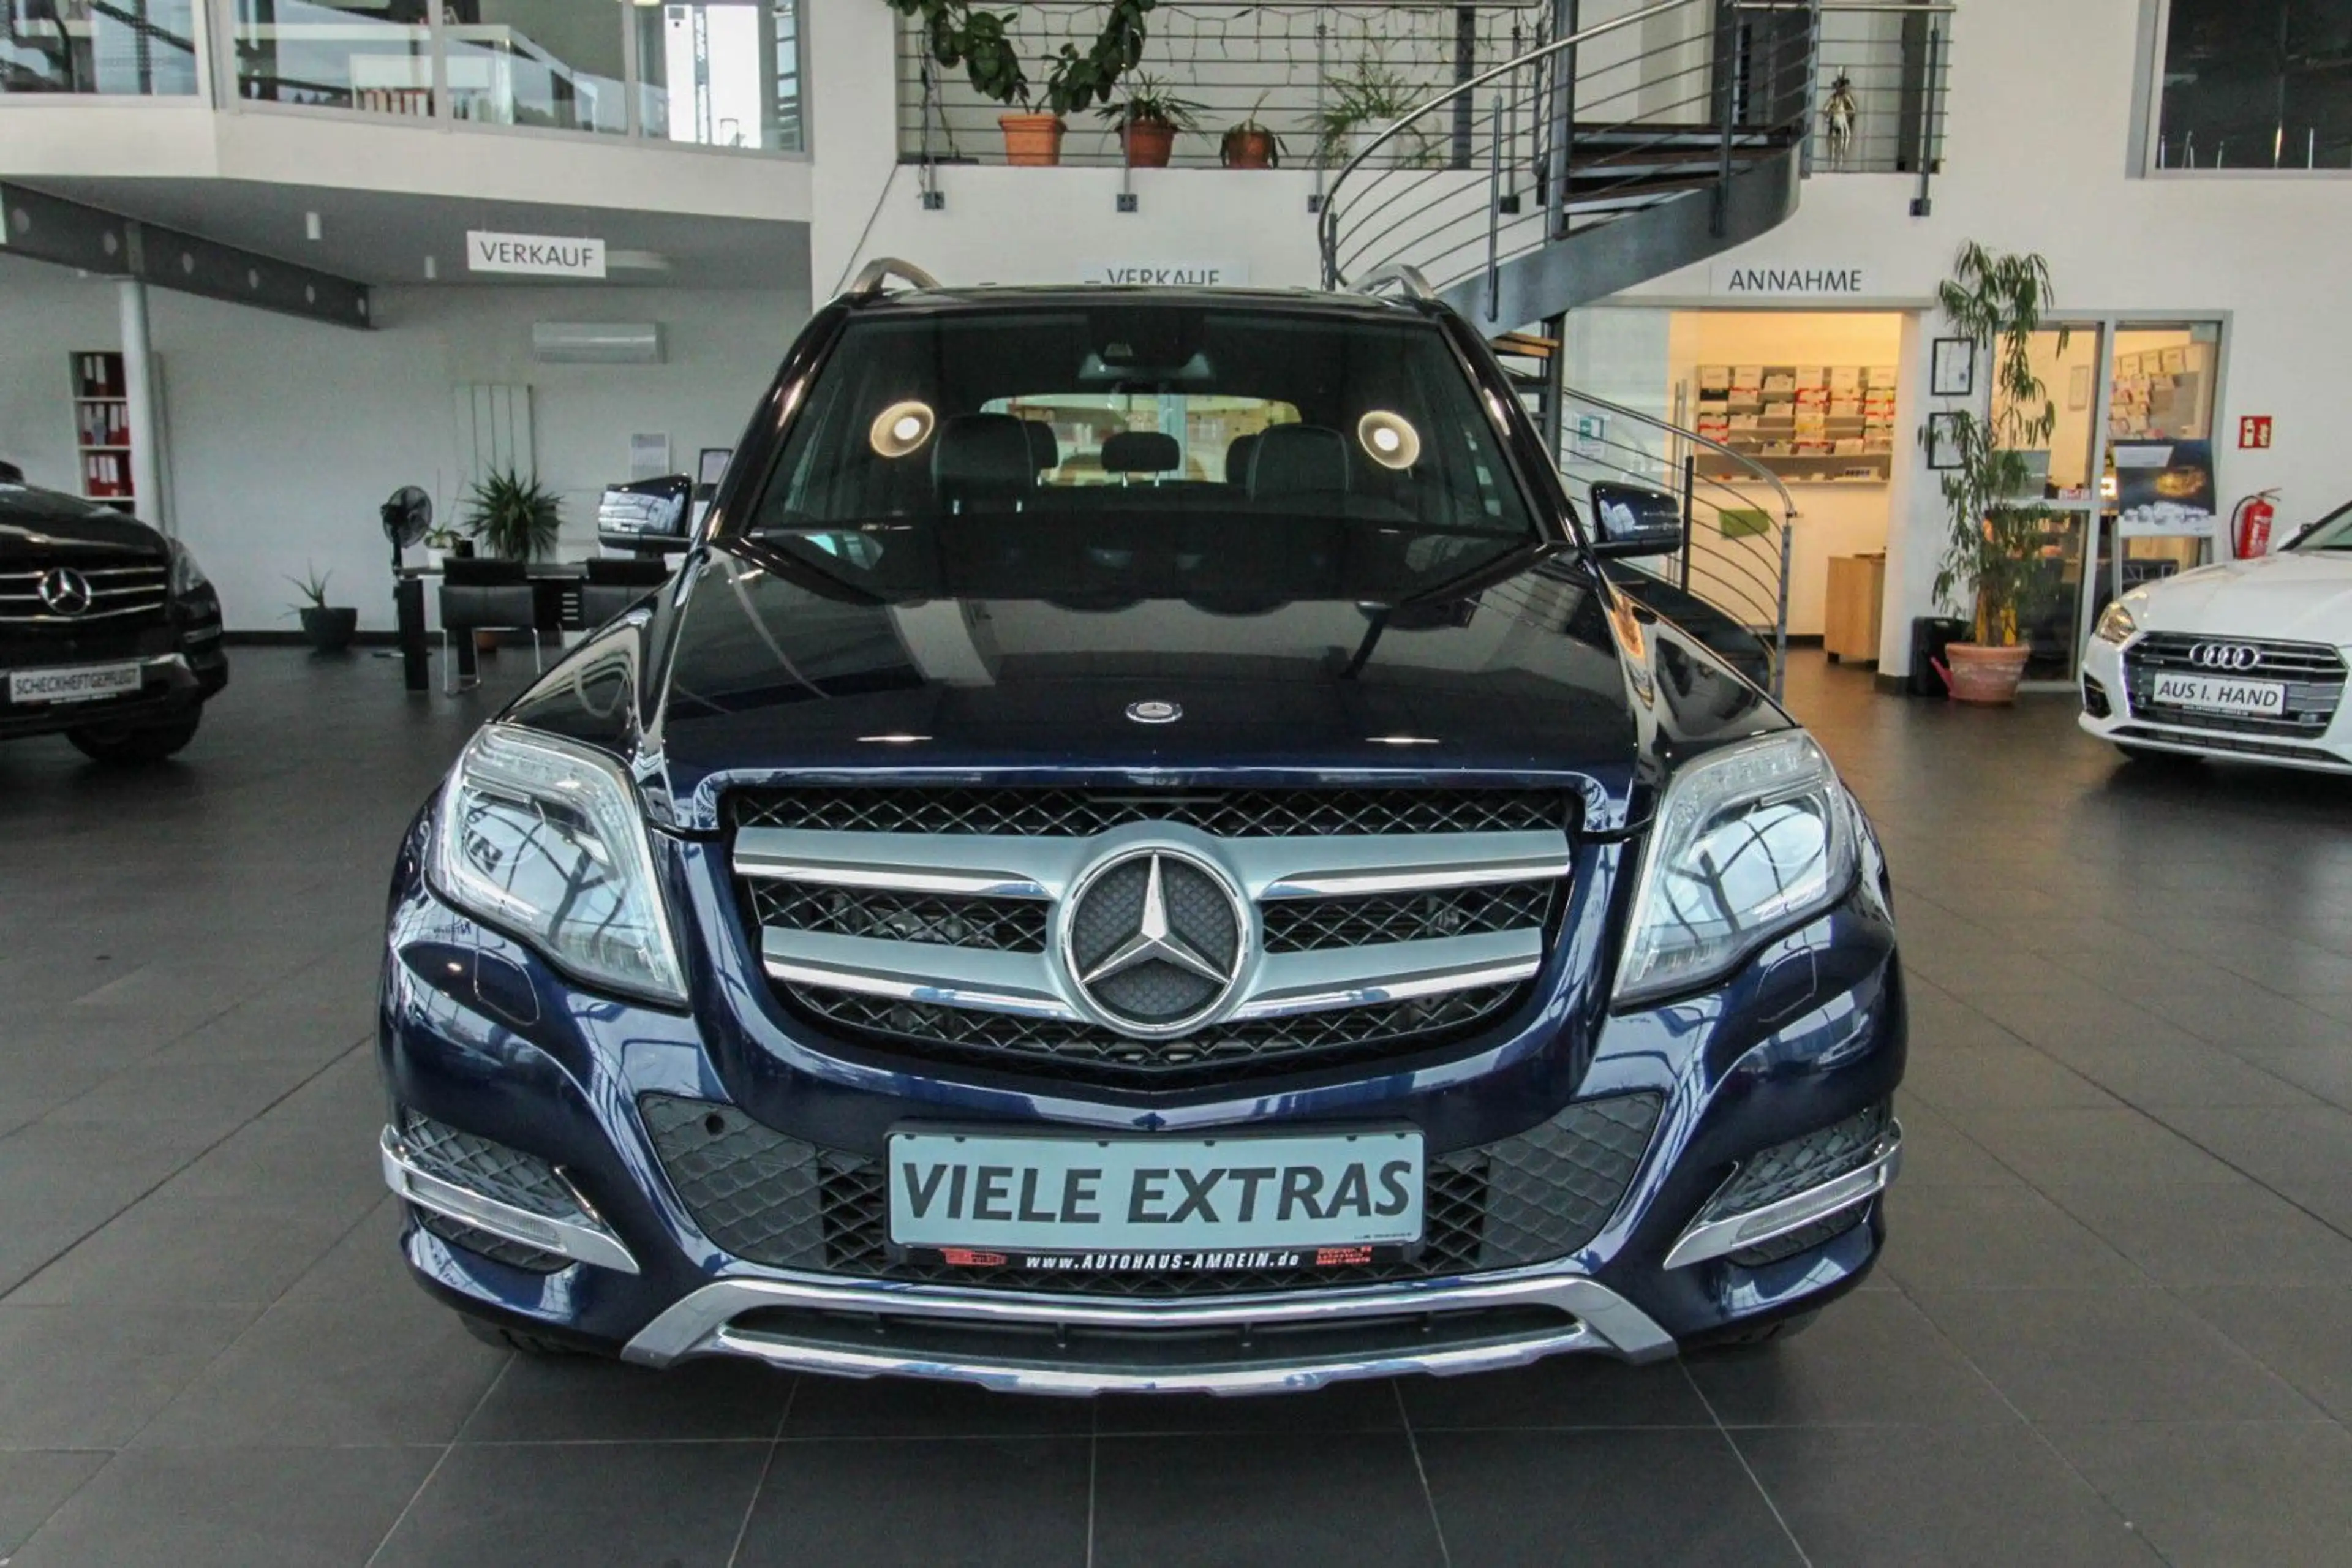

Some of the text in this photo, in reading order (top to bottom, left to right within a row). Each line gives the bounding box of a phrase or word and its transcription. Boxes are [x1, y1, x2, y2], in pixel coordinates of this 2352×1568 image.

[480, 241, 594, 268] VERKAUF
[1728, 270, 1863, 292] ANNAHME
[2158, 680, 2196, 699] AUS
[2217, 687, 2278, 707] HAND
[902, 1160, 1412, 1224] VIELE EXTRAS
[1025, 1250, 1300, 1270] www.AUTOHAUS-AMREIN.de
